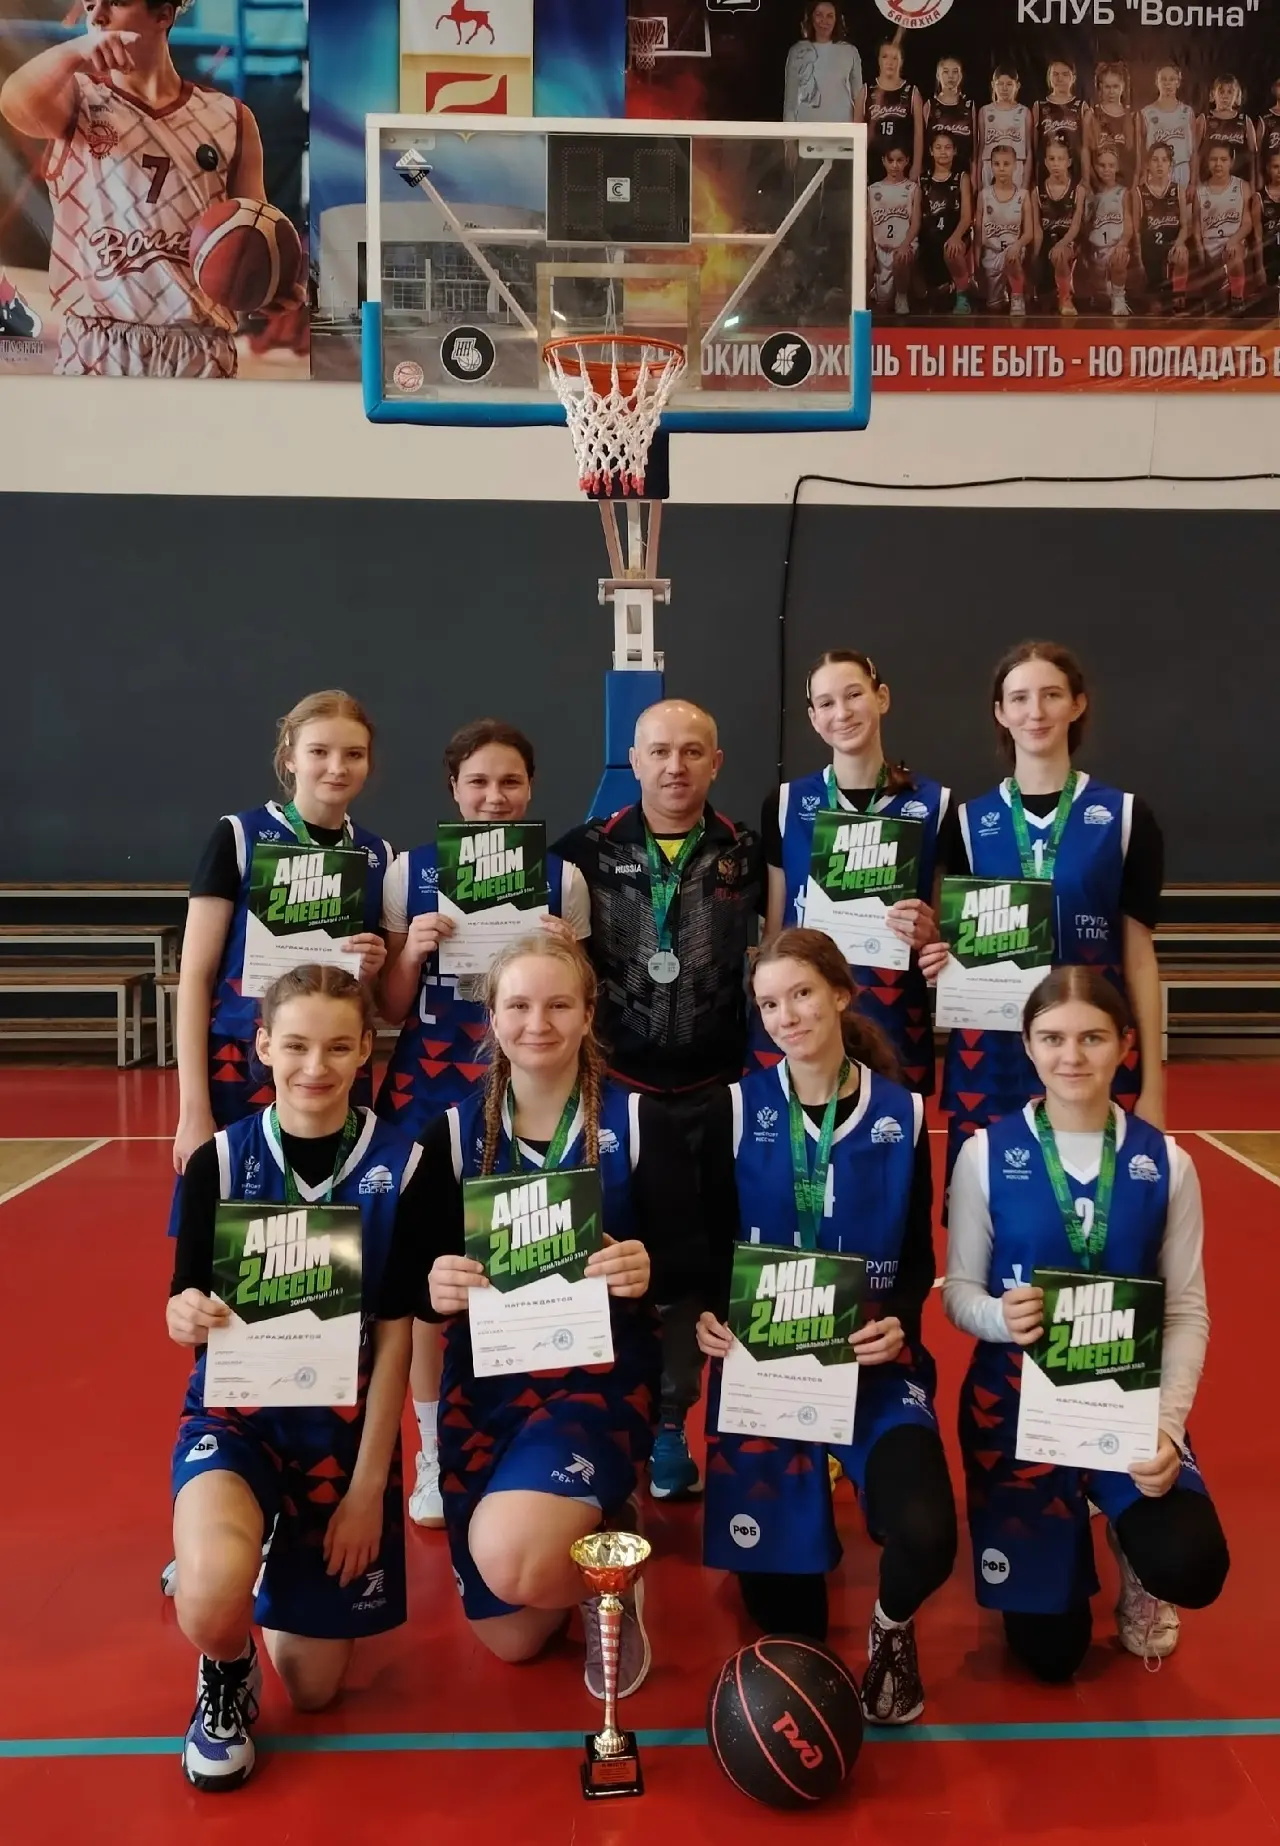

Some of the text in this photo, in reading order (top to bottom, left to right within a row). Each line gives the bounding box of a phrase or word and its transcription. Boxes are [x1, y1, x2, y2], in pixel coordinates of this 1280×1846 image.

[887, 10, 941, 28] БАЛАХНА
[1017, 0, 1259, 27] КЛУБ "Волна"
[880, 121, 894, 136] 15
[142, 153, 171, 204] 7
[887, 225, 894, 239] 2
[936, 217, 945, 230] 4
[1102, 231, 1108, 244] 1
[1155, 232, 1164, 244] 2
[906, 345, 945, 376] ТЫ
[952, 345, 985, 377] НЕ
[992, 345, 1064, 377] БЫТЬ
[1089, 346, 1124, 377] НО
[1130, 346, 1266, 380] ПОПАДАТЬ
[458, 827, 505, 865] ДИП
[832, 820, 883, 853] ДИП
[273, 852, 325, 886] ДИП
[474, 846, 524, 882] ЛОМ
[615, 864, 642, 874] RUSSIA
[825, 854, 897, 890] 2 МЕСТО
[845, 841, 898, 872] ЛОМ
[287, 873, 342, 905] ЛОМ
[456, 866, 526, 902] 2 МЕСТО
[961, 884, 1012, 920] ДИП
[267, 887, 342, 924] 2 МЕСТО
[976, 904, 1029, 937] ЛОМ
[1075, 914, 1108, 927] ГРУП
[957, 920, 1030, 957] 2 МЕСТО
[491, 1177, 548, 1231] ДИП
[243, 1209, 308, 1257] ДИП
[511, 1198, 572, 1250] ЛОМ
[262, 1234, 331, 1280] ЛОМ
[489, 1228, 576, 1276] 2 МЕСТО
[539, 1256, 574, 1273] ЗОНАЛЬНЫЙ
[866, 1260, 898, 1274] РУПП
[236, 1256, 333, 1307] 2 МЕСТО
[755, 1257, 816, 1300] ДИП
[772, 1284, 836, 1323] ЛОМ
[1052, 1281, 1115, 1324] ДИП
[748, 1300, 835, 1347] 2 МЕСТО
[1069, 1308, 1135, 1348] ЛОМ
[1046, 1324, 1135, 1372] 2 МЕСТО
[733, 1524, 757, 1537] РФБ
[982, 1559, 1006, 1573] РФБ
